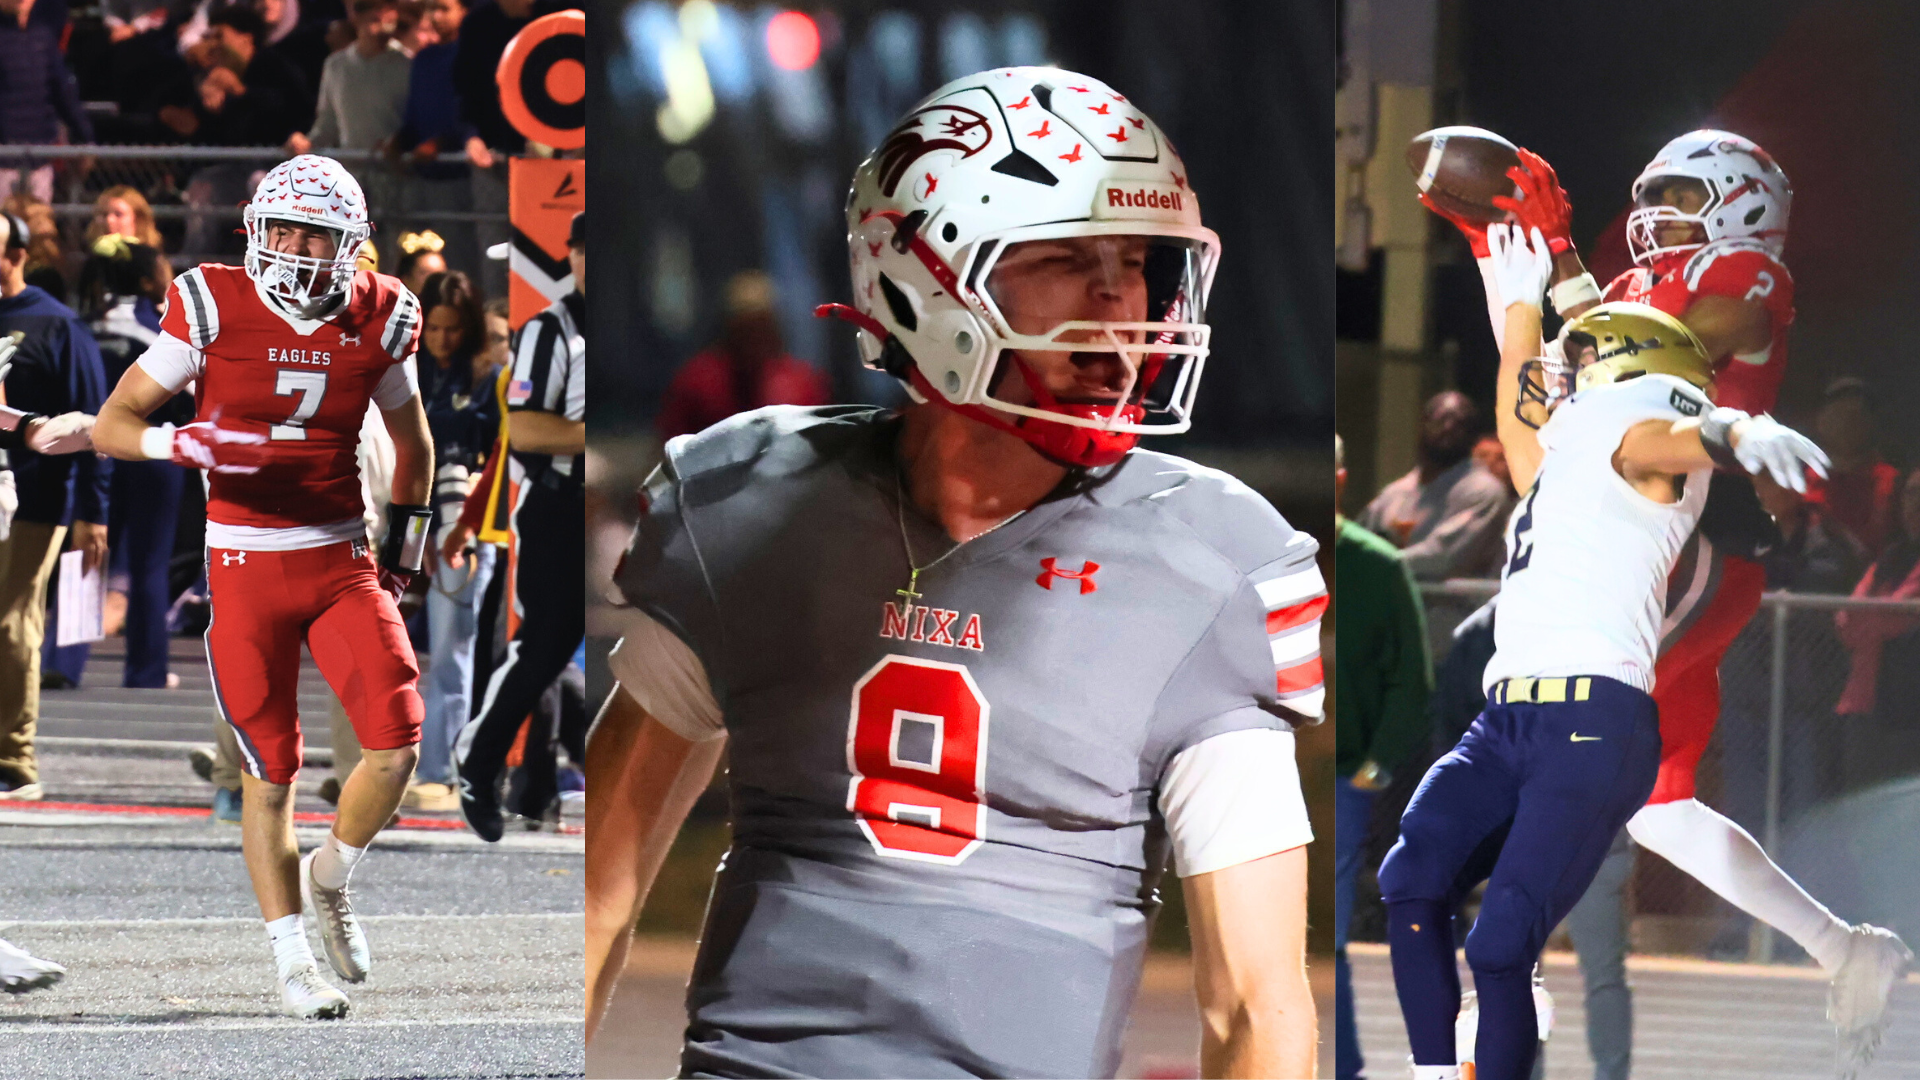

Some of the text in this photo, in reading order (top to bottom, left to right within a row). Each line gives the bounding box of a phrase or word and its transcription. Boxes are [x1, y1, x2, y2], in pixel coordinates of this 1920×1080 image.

[1106, 188, 1182, 211] Riddell
[1744, 270, 1775, 301] 2
[268, 347, 331, 366] EAGLES
[269, 367, 329, 441] 7
[879, 601, 984, 652] NIXA
[846, 653, 991, 866] 8
